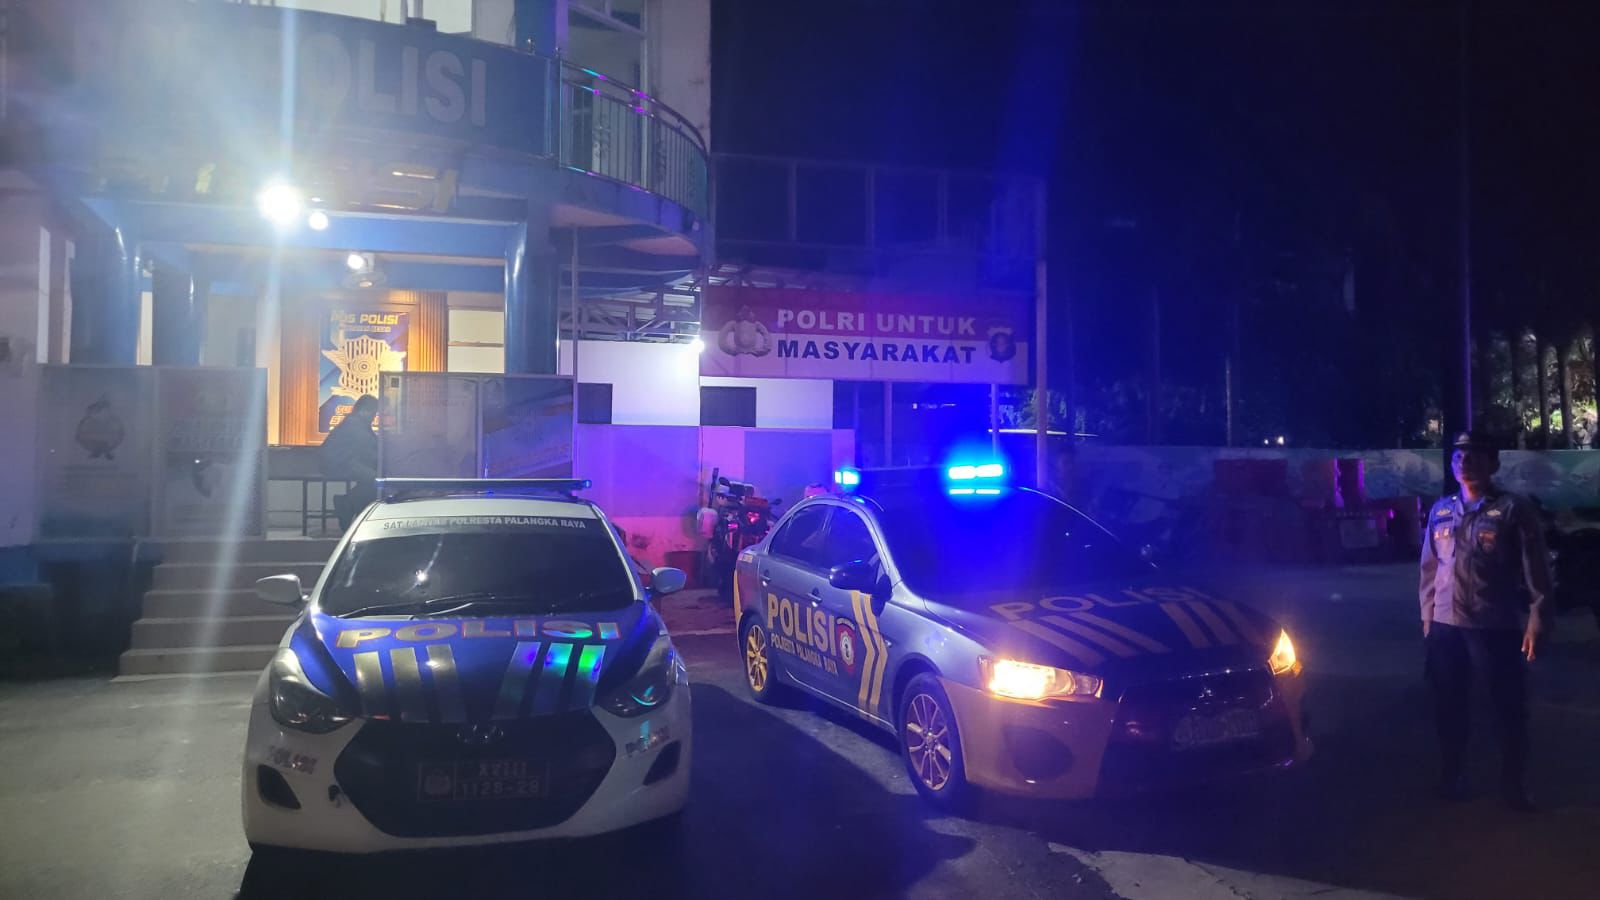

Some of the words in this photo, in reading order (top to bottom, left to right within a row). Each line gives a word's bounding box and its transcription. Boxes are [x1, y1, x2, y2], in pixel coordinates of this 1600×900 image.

[256, 26, 488, 128] OLISI
[360, 313, 399, 325] POLISI
[777, 308, 865, 332] POLRI
[877, 313, 977, 337] UNTUK
[777, 339, 977, 365] MASYARAKAT
[383, 520, 403, 530] SAT
[505, 517, 558, 527] PALANGKA
[560, 518, 586, 529] RAYA
[988, 586, 1213, 622] POLISI
[336, 621, 621, 648] POLISI
[766, 592, 837, 657] POLISI
